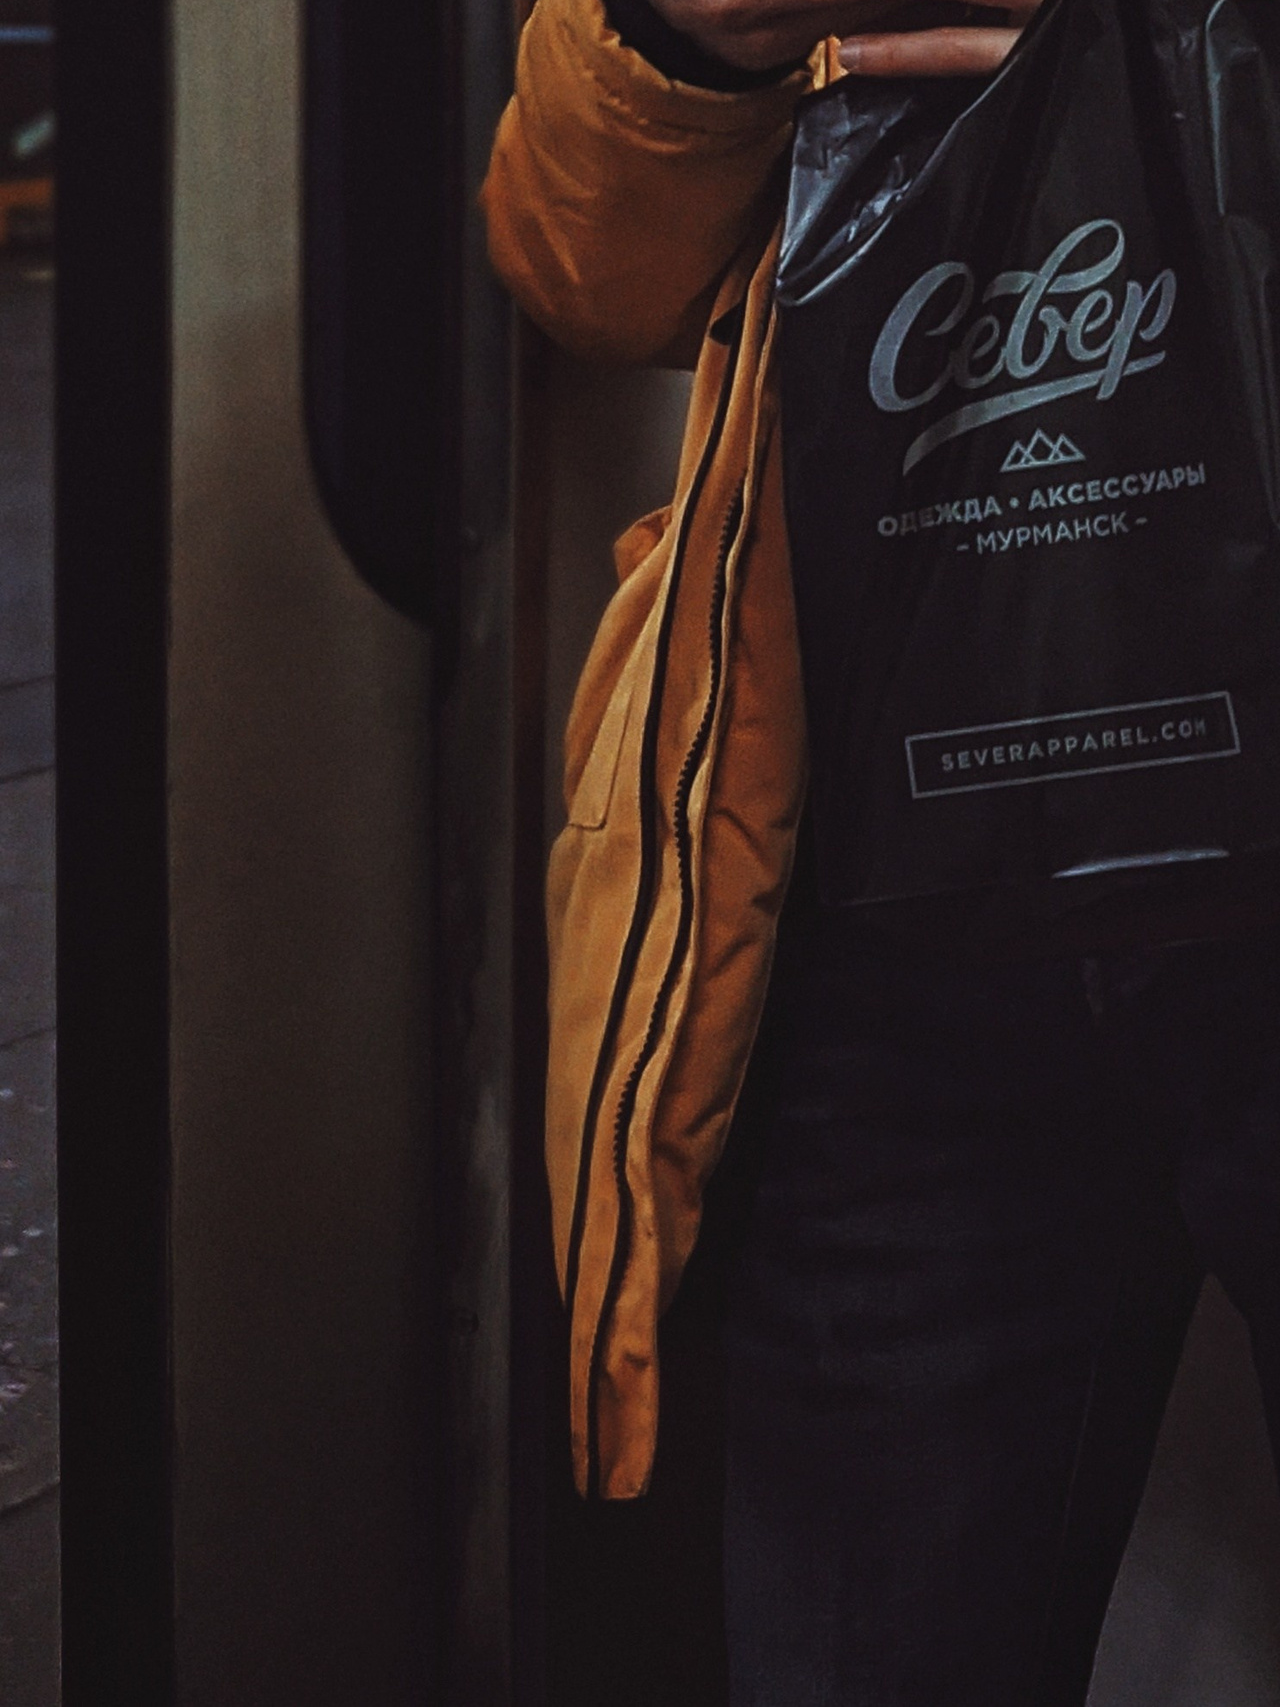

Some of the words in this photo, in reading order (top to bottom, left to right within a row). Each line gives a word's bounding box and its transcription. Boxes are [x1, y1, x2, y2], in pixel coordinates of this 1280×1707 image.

[869, 218, 1177, 414] Север
[877, 494, 1003, 538] ОДЕЖДА
[1028, 463, 1207, 511] АКСЕССУАРЫ
[976, 510, 1130, 556] МУРМАНСК
[941, 716, 1208, 773] SEVERAPPAREL.COM
